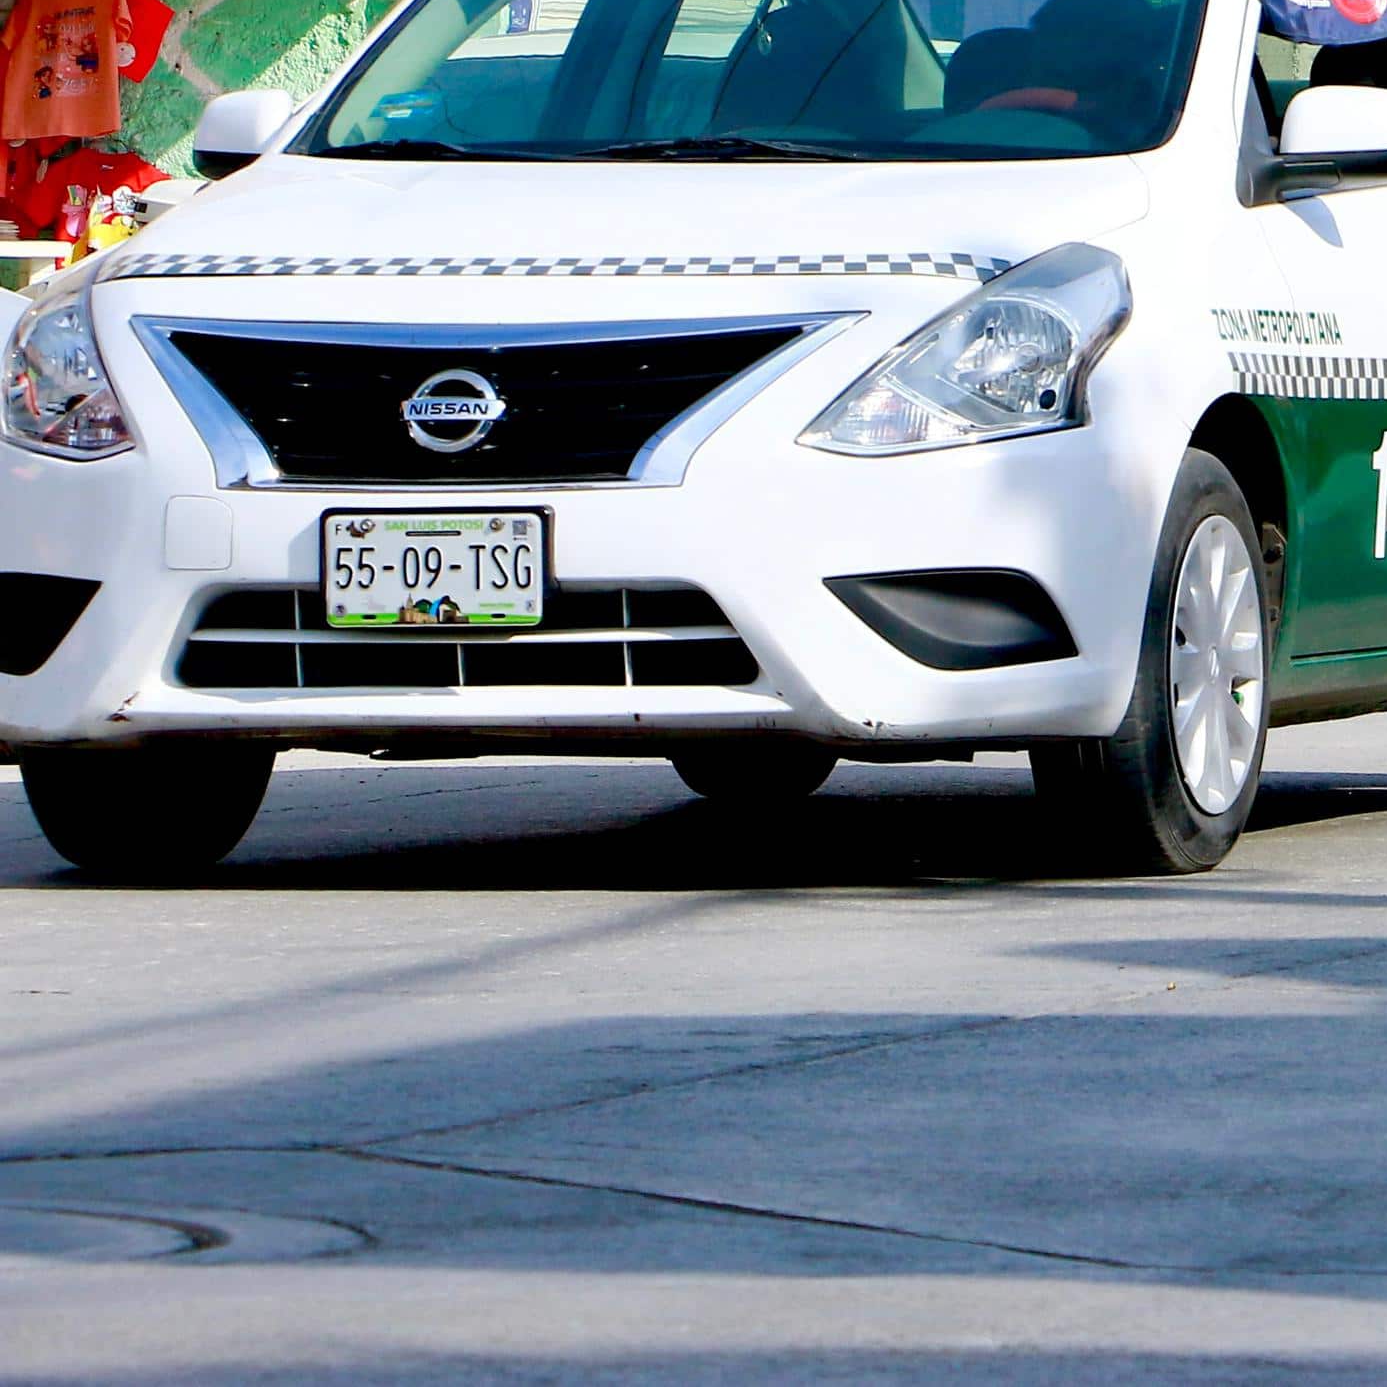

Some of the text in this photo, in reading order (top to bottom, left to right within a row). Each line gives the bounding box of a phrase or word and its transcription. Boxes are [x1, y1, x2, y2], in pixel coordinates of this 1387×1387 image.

[1211, 309, 1343, 345] ZONA METROPOLITANA
[409, 403, 489, 415] NISSAN
[384, 520, 408, 531] SAN
[413, 520, 438, 530] LUIS
[336, 544, 532, 590] 55-09-TSG
